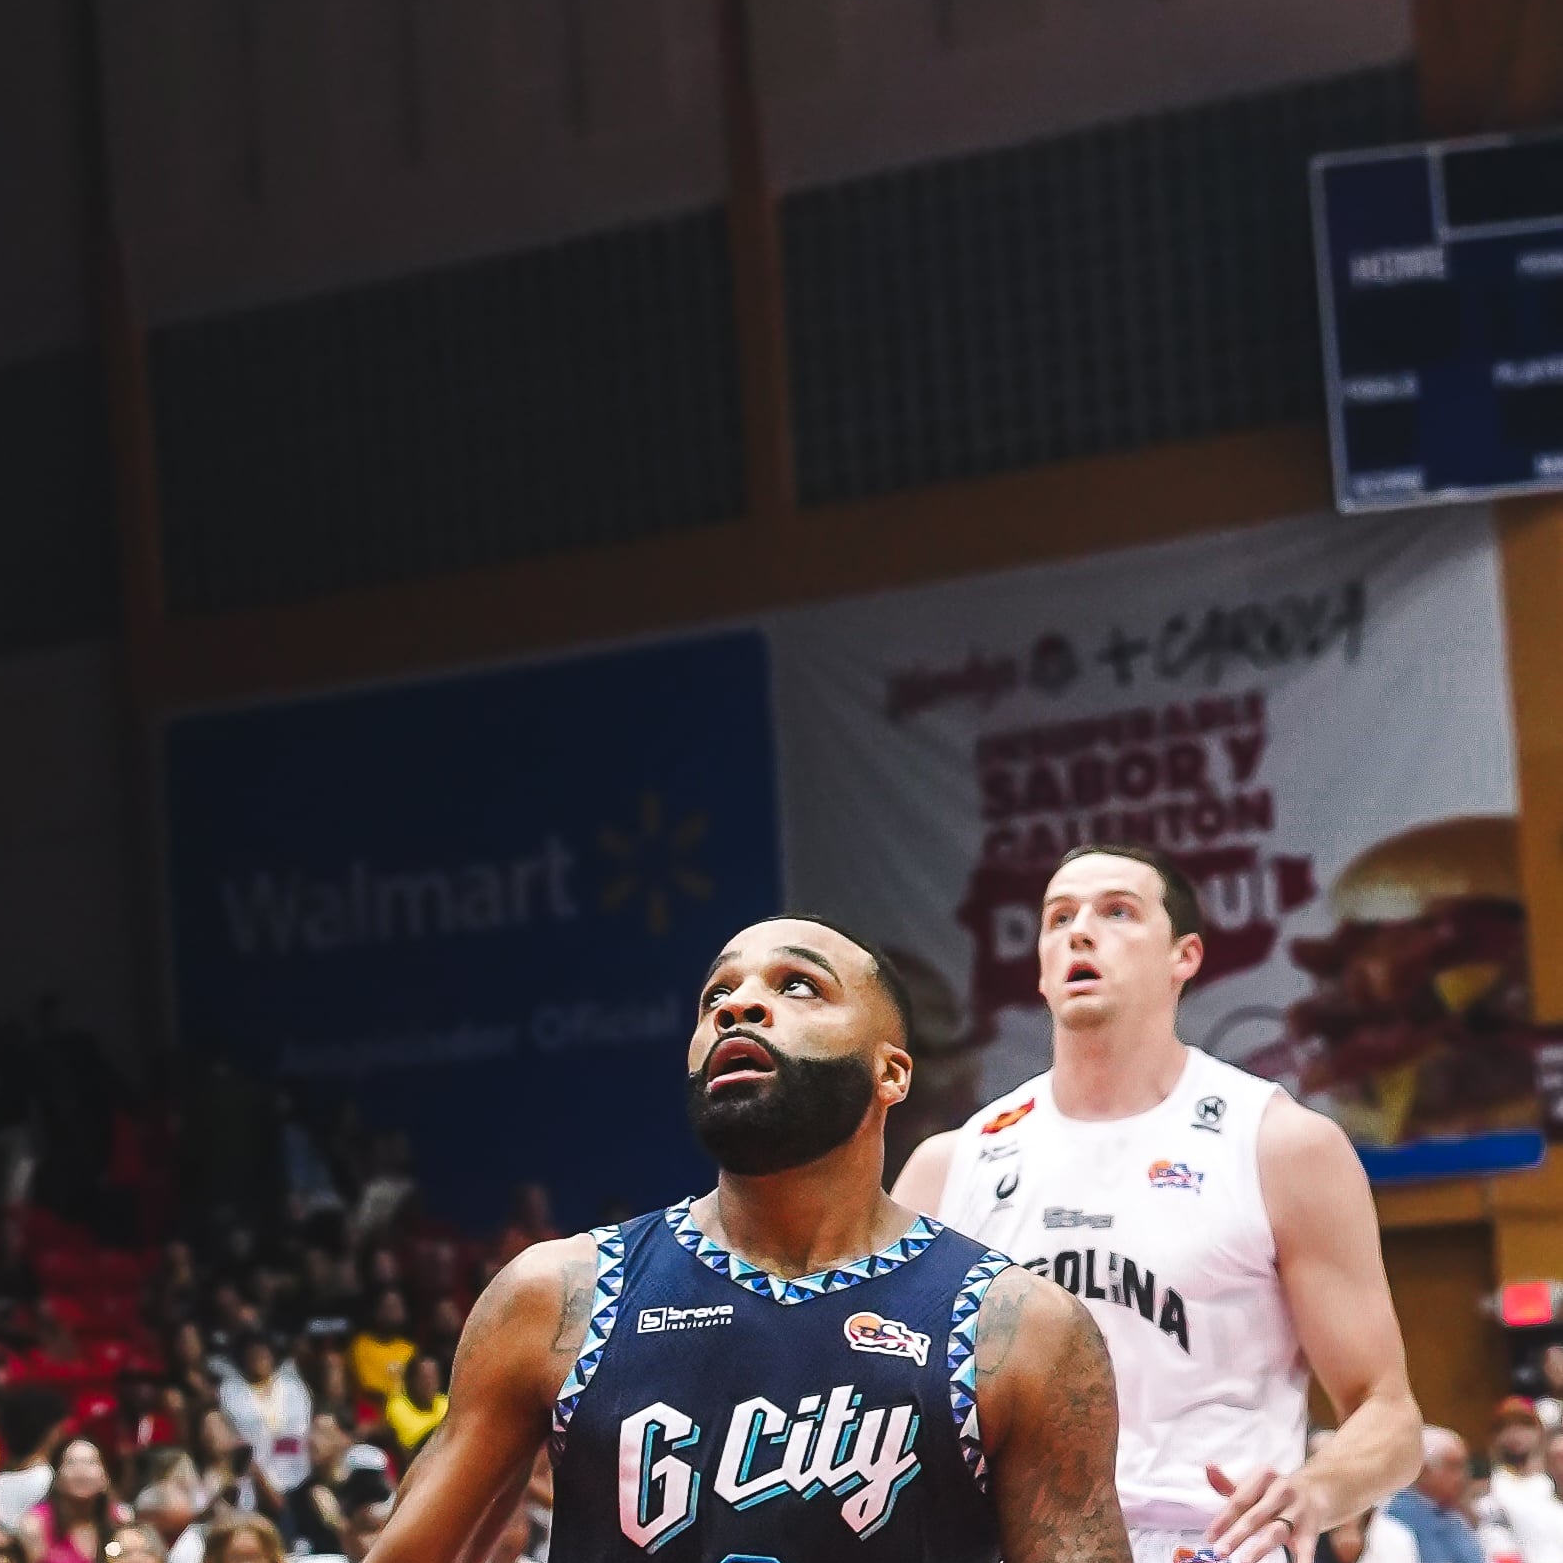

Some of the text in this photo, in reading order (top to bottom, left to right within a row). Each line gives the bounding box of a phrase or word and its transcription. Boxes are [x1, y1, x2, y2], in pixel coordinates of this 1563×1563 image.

[220, 831, 579, 957] Walmart
[619, 1384, 922, 1555] G City
